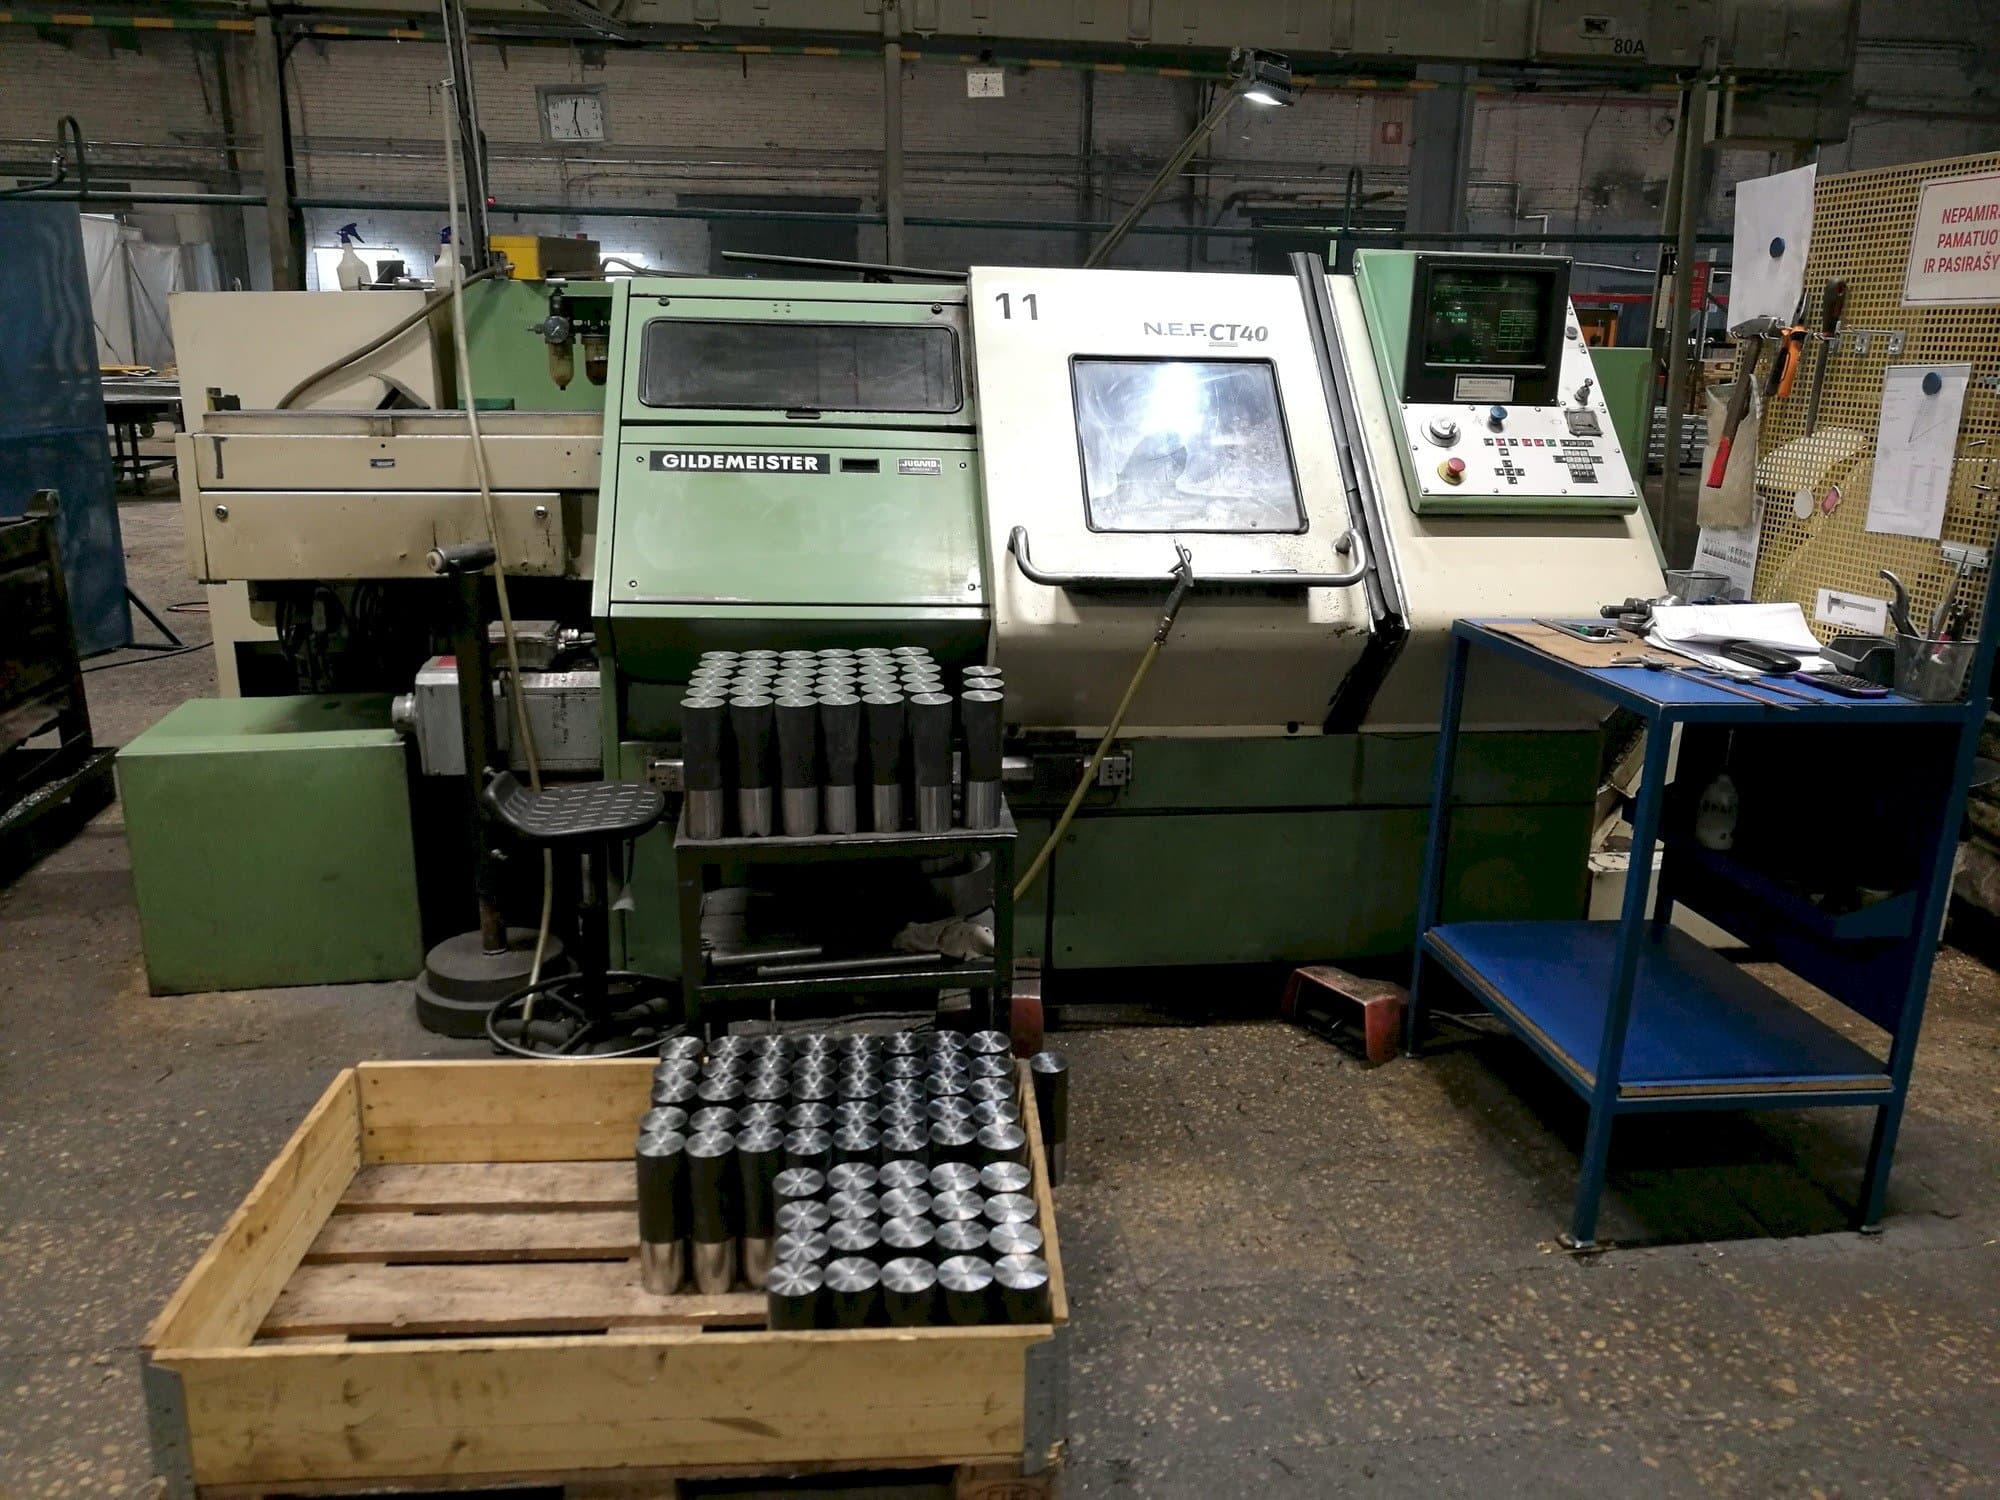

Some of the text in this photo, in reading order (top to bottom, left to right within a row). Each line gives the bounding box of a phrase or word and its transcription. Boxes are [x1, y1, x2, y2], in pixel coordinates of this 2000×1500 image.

[1614, 39, 1645, 54] 80A
[1942, 204, 2000, 224] NEPAMIR
[1937, 229, 2000, 248] PAMATUO
[1923, 258, 1936, 274] IR
[995, 292, 1038, 321] 11
[661, 452, 819, 472] GILDEMEISTER
